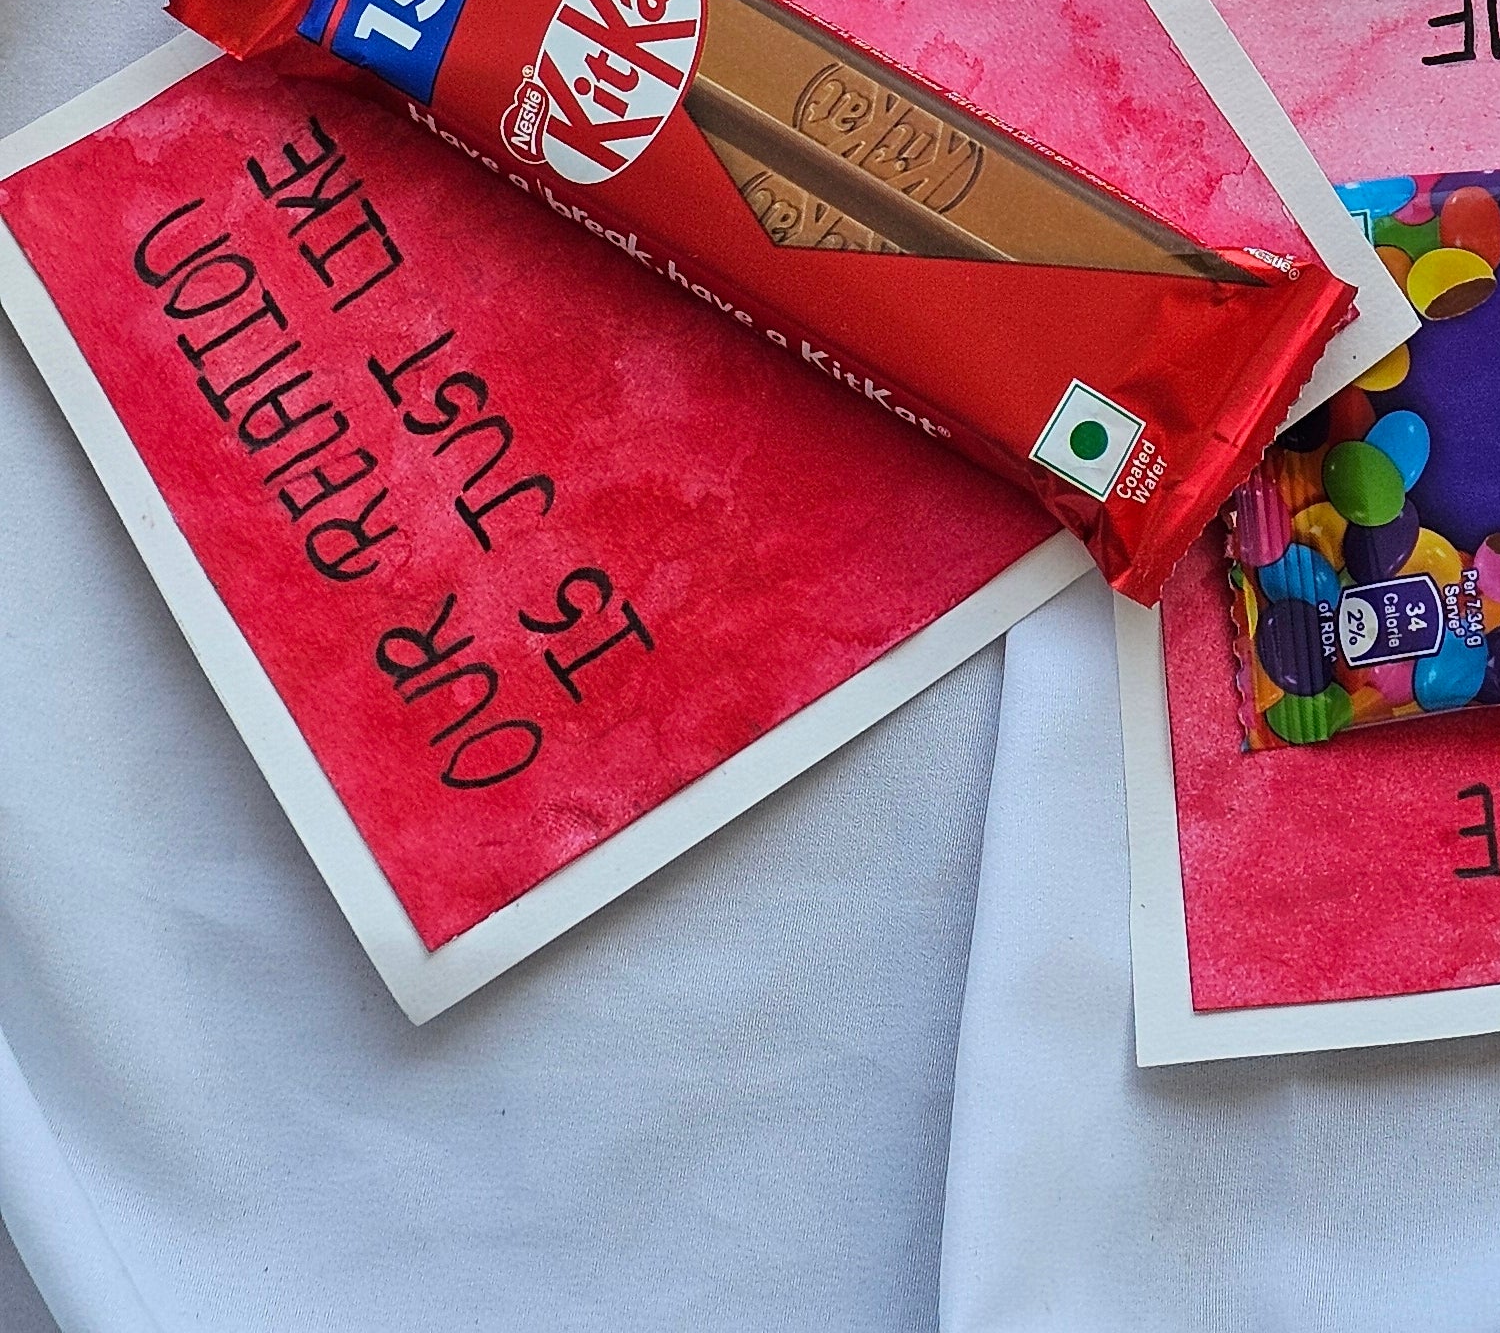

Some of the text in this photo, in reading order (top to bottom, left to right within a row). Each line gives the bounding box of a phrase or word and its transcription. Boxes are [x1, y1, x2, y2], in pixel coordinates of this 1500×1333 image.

[511, 86, 545, 152] Nestlé
[407, 103, 499, 174] Have
[509, 174, 530, 193] a
[667, 259, 754, 328] have
[765, 330, 787, 348] a
[244, 114, 656, 703] IS JUST LIKE
[133, 199, 542, 790] OUR RELATION
[1116, 439, 1156, 499] Coated
[1132, 455, 1168, 504] Wafer
[1318, 602, 1329, 618] of
[1463, 569, 1477, 597] Per
[1347, 609, 1365, 646] 2%
[1383, 592, 1402, 647] Calorie
[1405, 602, 1427, 632] 34
